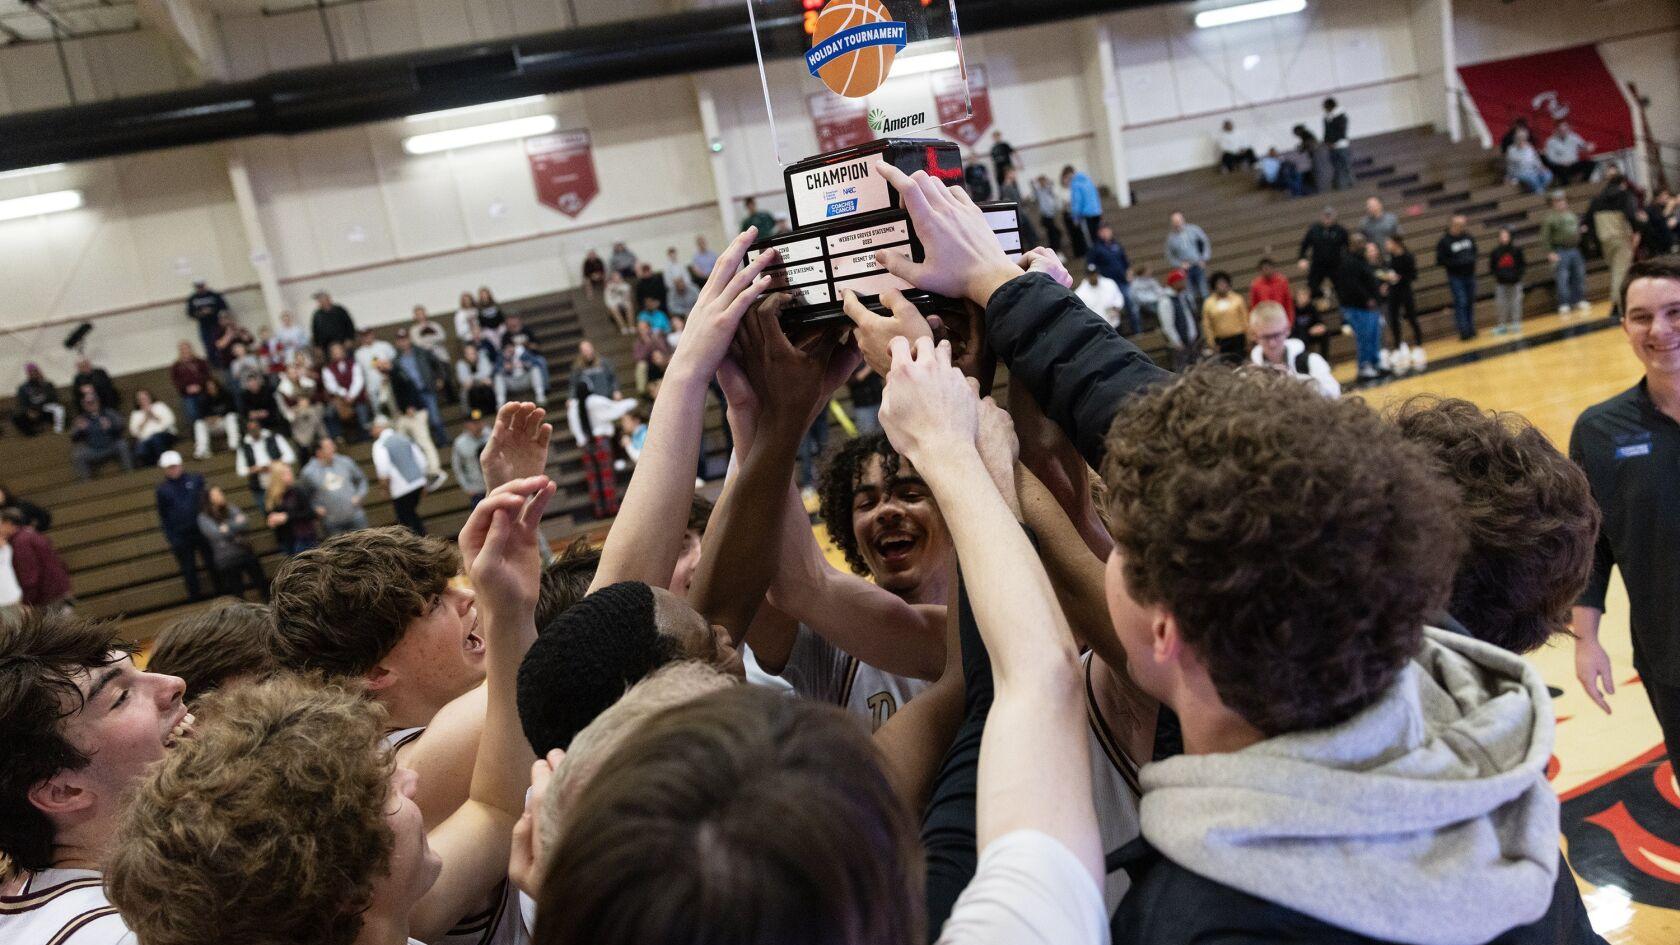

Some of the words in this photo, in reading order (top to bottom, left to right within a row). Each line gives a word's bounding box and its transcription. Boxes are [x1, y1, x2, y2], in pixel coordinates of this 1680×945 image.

[809, 38, 844, 66] HOLIDAY
[844, 27, 904, 47] TOURNAMENT
[883, 111, 925, 134] Ameren
[806, 161, 869, 191] CHAMPION
[838, 234, 857, 243] WEBSTER
[856, 230, 872, 239] GROVES
[871, 226, 896, 236] STATESMEN
